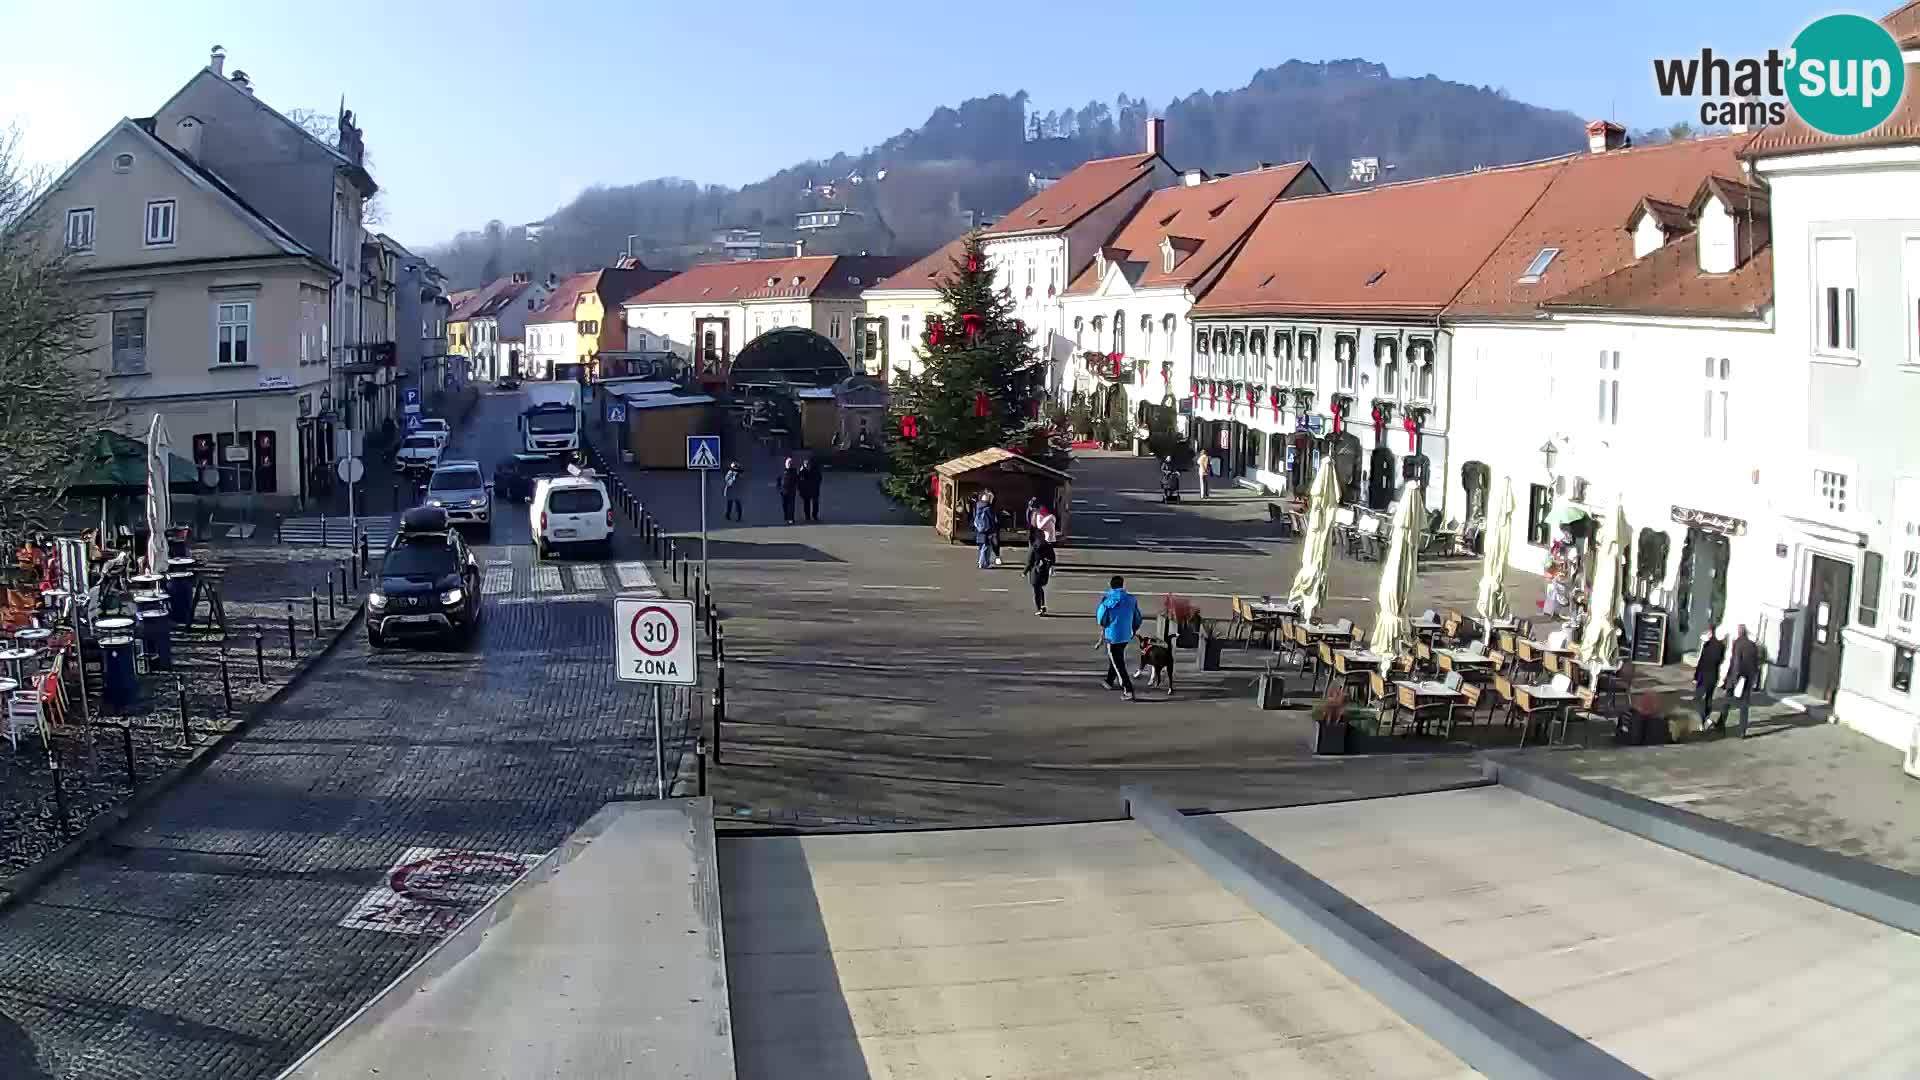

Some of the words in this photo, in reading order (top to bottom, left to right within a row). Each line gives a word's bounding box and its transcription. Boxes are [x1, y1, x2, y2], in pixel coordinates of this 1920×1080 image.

[408, 391, 416, 401] P
[643, 621, 668, 643] 30
[633, 659, 679, 677] ZONA
